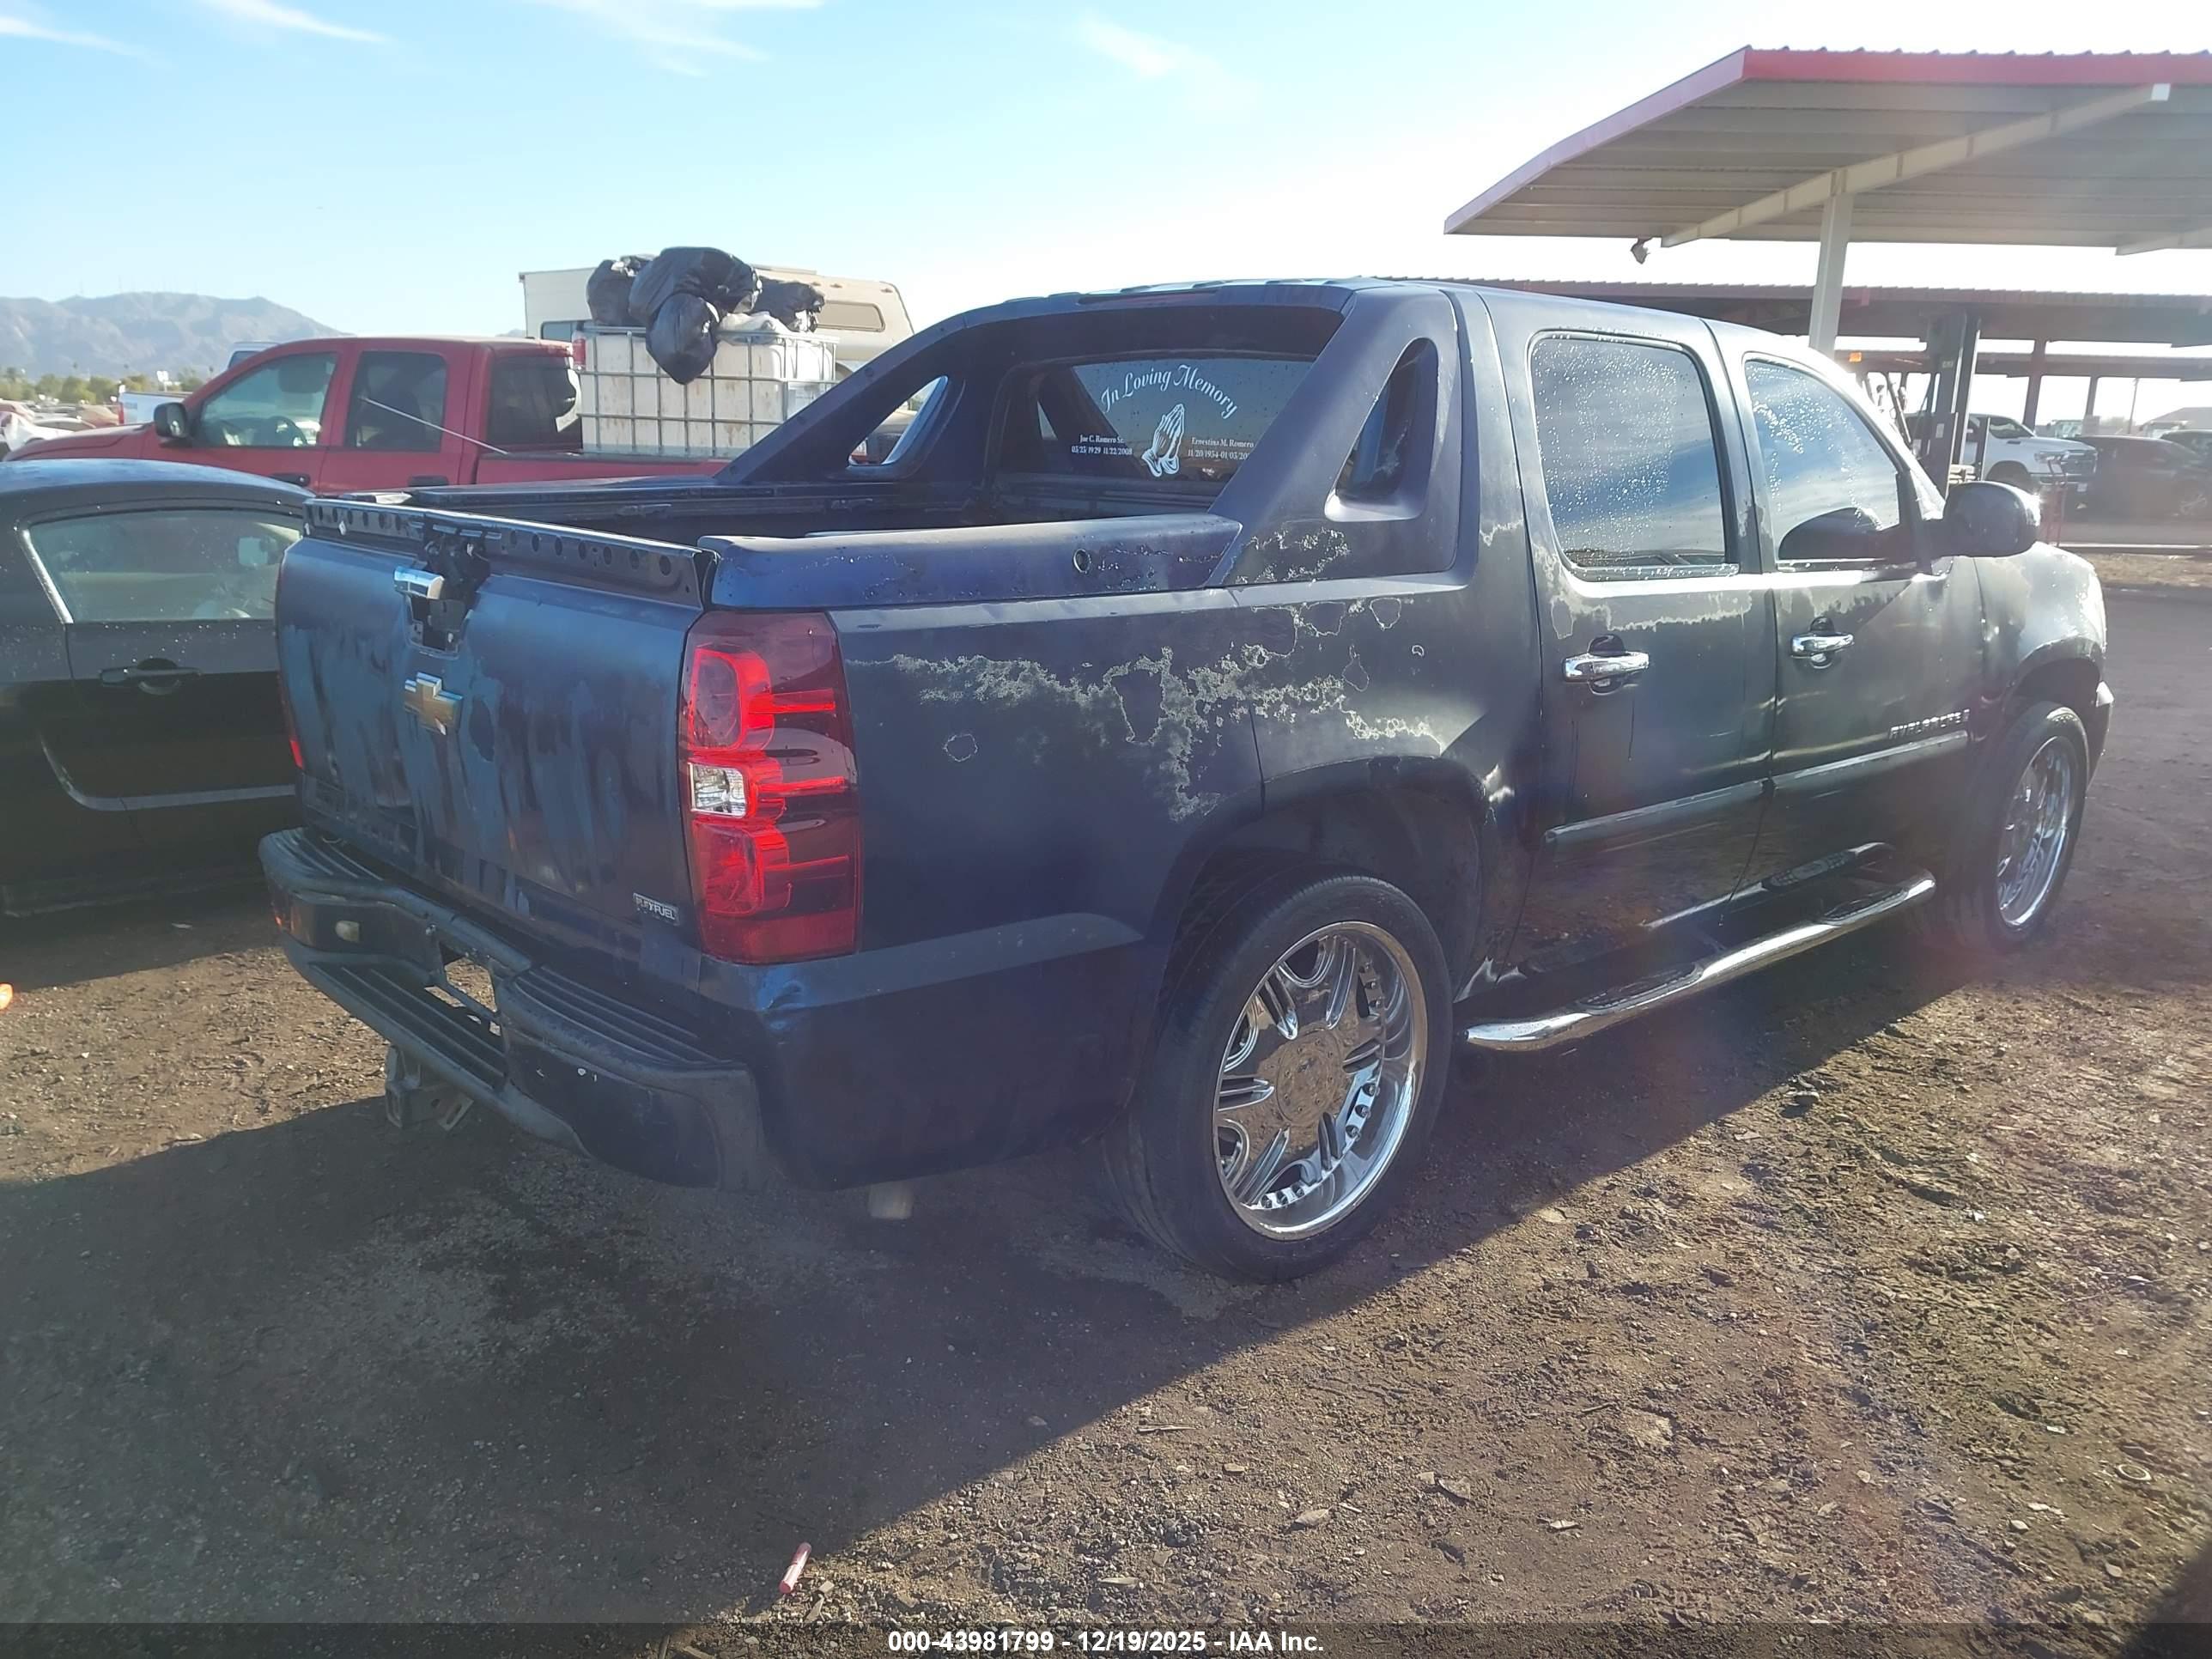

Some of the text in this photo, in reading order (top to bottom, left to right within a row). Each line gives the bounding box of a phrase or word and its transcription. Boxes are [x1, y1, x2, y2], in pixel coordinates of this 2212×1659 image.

[1101, 364, 1238, 419] In Loving Memory
[1191, 436, 1255, 448] Ernestina M. Romero
